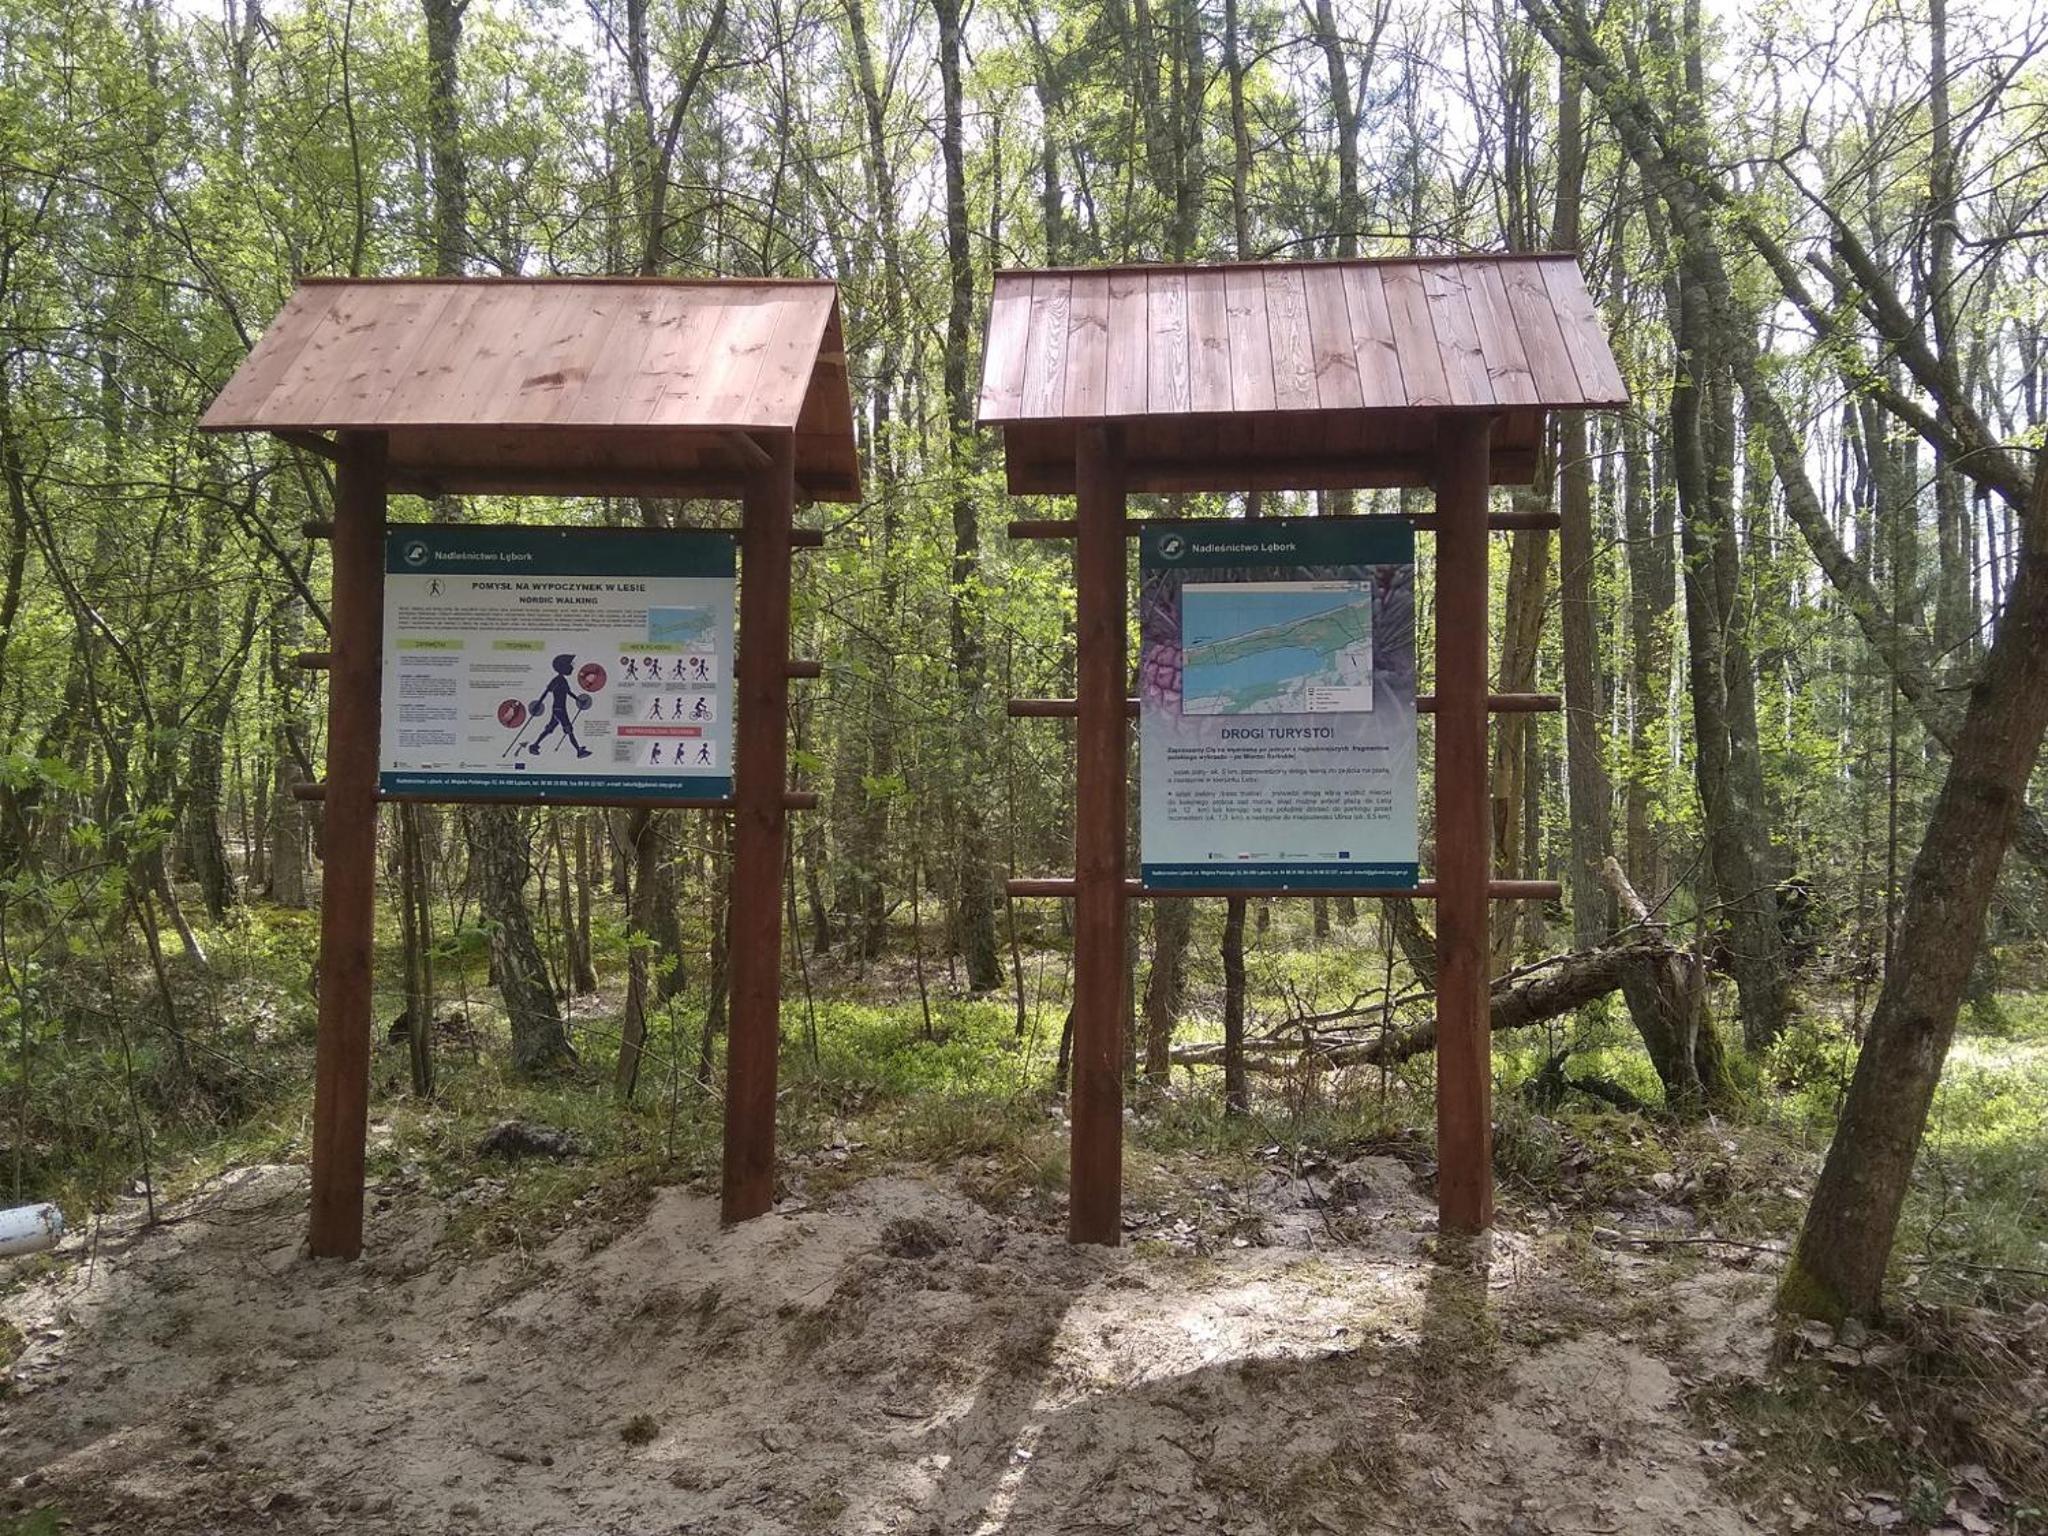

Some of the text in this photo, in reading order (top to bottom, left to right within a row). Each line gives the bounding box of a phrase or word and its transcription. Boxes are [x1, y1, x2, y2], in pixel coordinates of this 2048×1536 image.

[1192, 541, 1296, 553] Nadleśnictwo Lębork
[434, 551, 533, 562] Nadleśnictwo Lębork
[472, 582, 646, 592] POMYSŁ NA WYPOCZYNEK W LESIE
[519, 596, 599, 605] NORDIC WALKING
[1221, 727, 1334, 739] DROGI TURYSTO!
